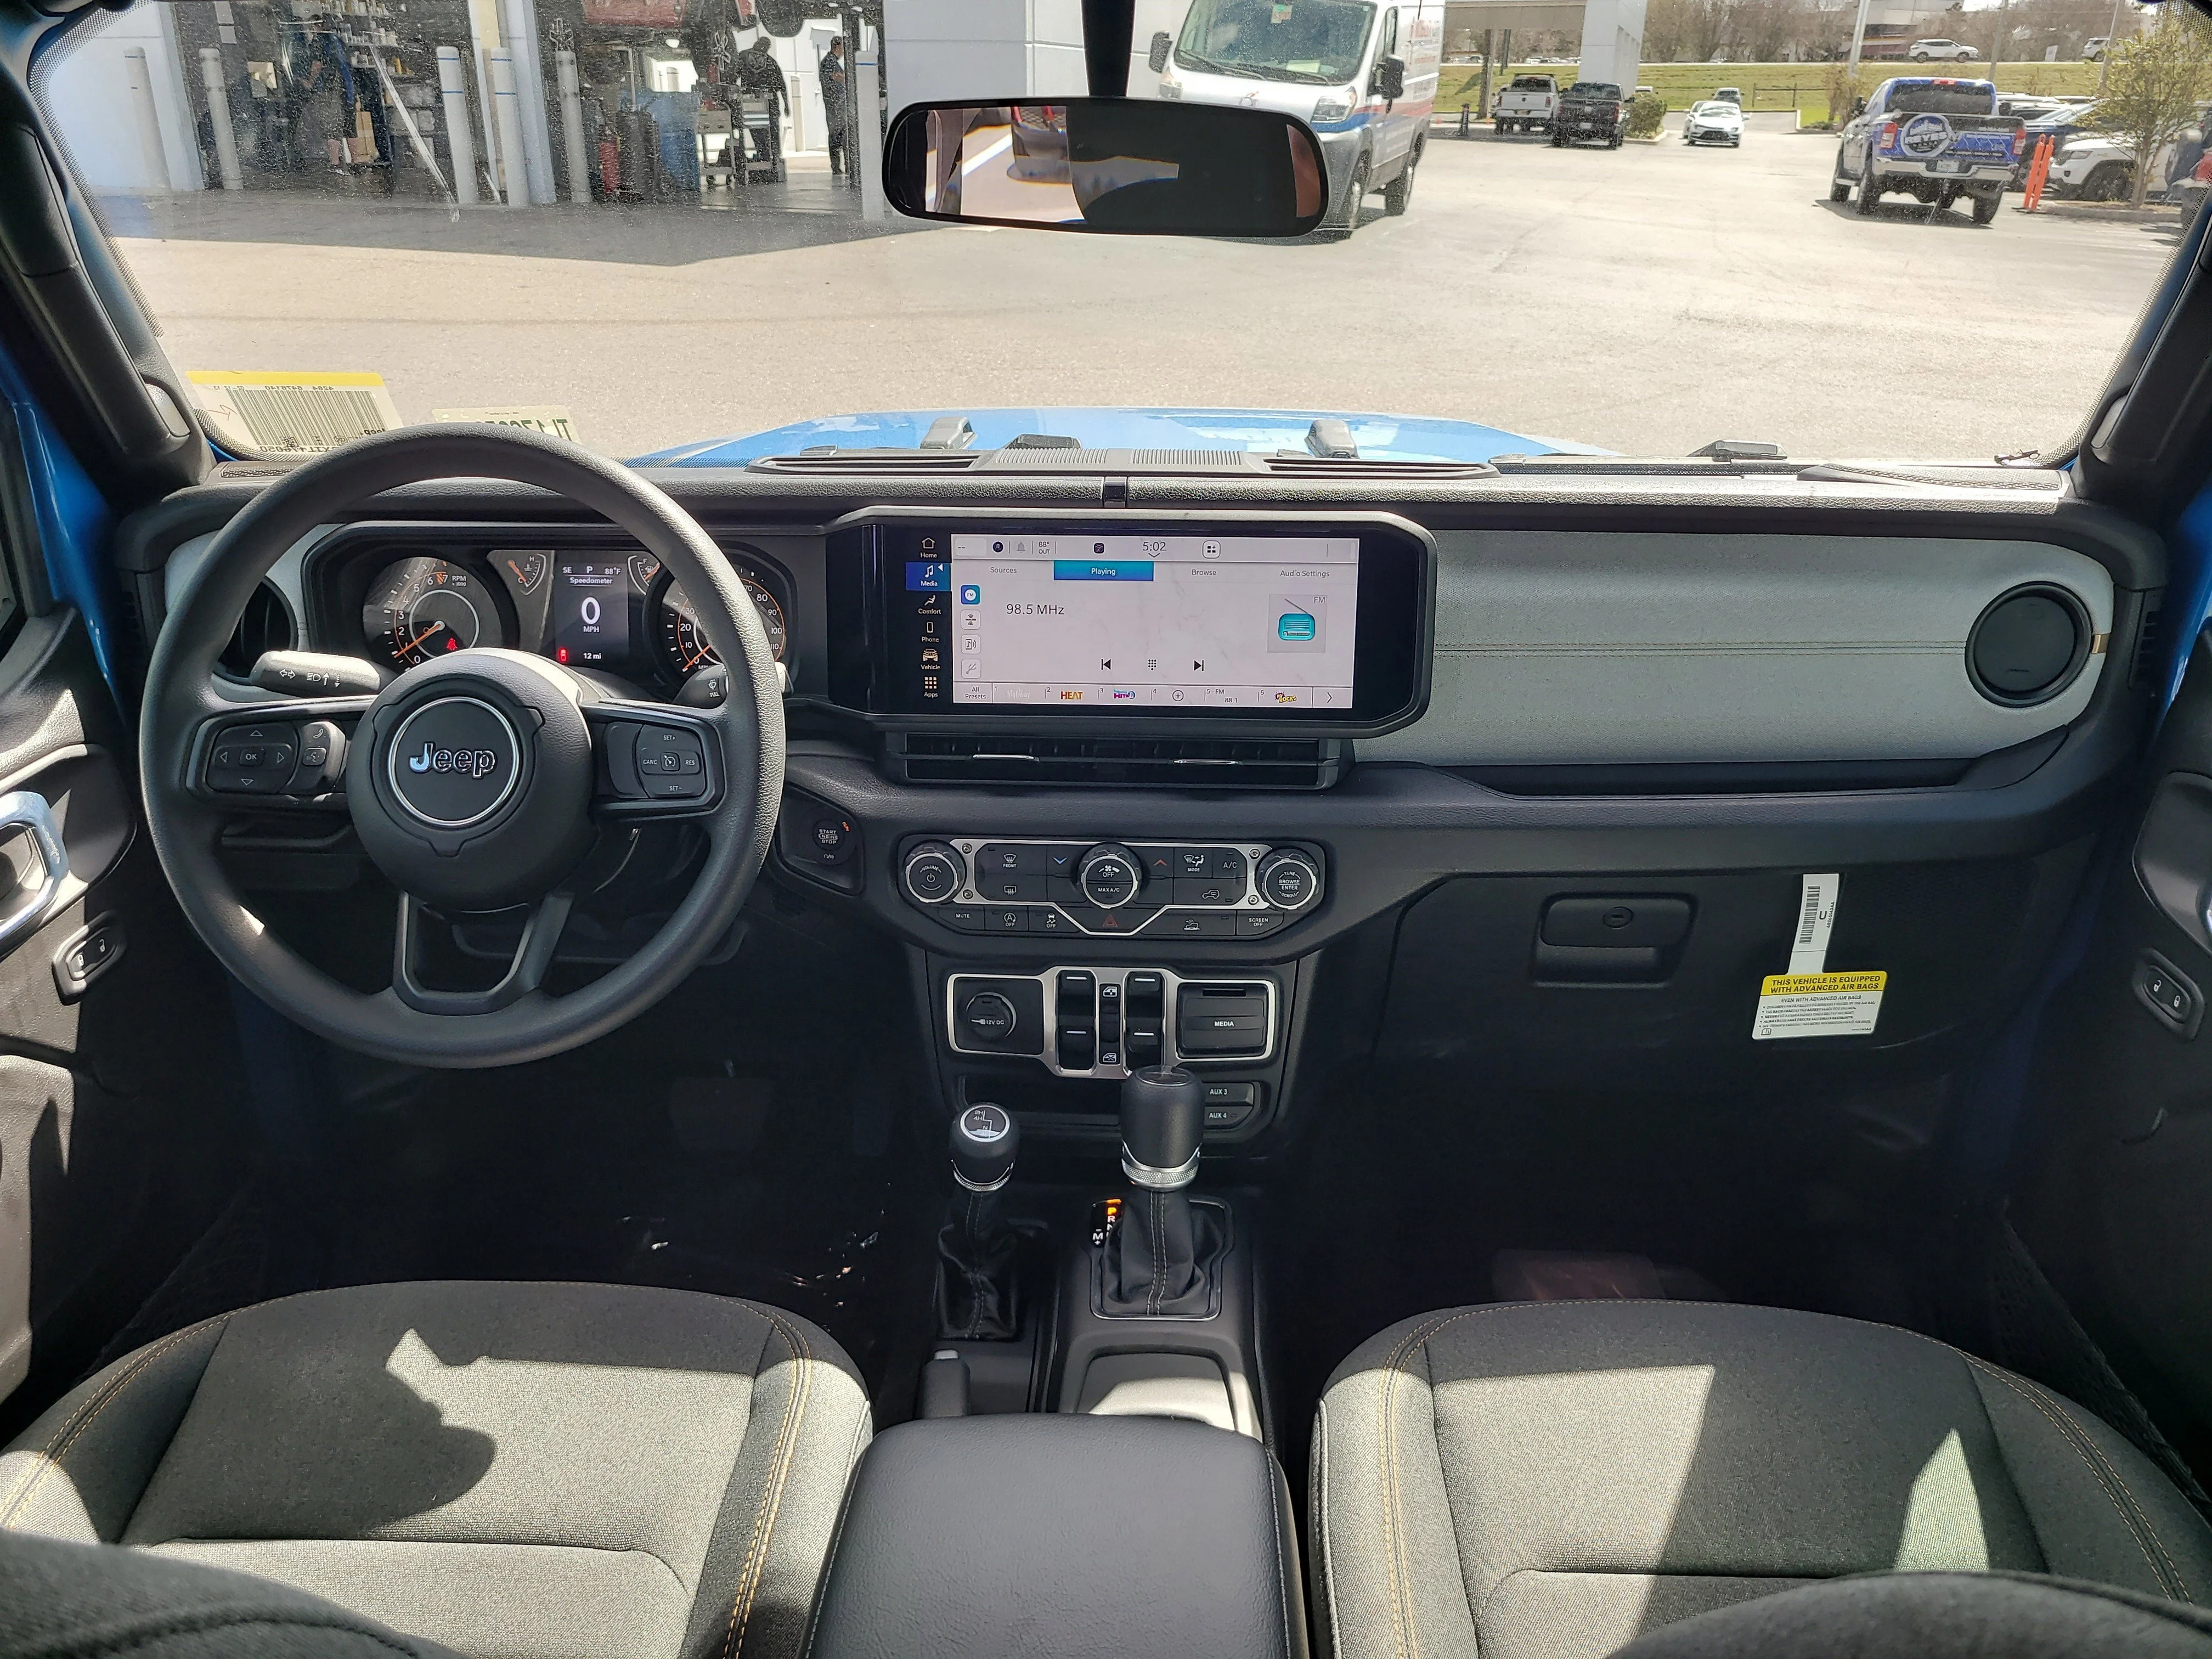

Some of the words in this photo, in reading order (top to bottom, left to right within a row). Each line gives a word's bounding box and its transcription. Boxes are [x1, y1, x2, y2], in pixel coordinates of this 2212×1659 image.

[1142, 541, 1166, 552] 5:02
[1091, 568, 1116, 577] Playing
[1302, 570, 1330, 578] Settings
[428, 577, 433, 585] 6
[414, 584, 420, 592] 5
[403, 596, 409, 604] 4
[581, 596, 601, 624] 0
[1006, 603, 1034, 615] 98.5
[1037, 603, 1065, 616] MHz
[398, 611, 404, 619] 3
[399, 627, 405, 635] 2
[414, 655, 421, 663] 0
[1007, 690, 1031, 699] highway
[1060, 691, 1083, 700] HEAT
[410, 742, 495, 778] Jeep
[1223, 861, 1237, 869] A/C
[1819, 911, 1827, 919] U
[1092, 1232, 1103, 1240] M
